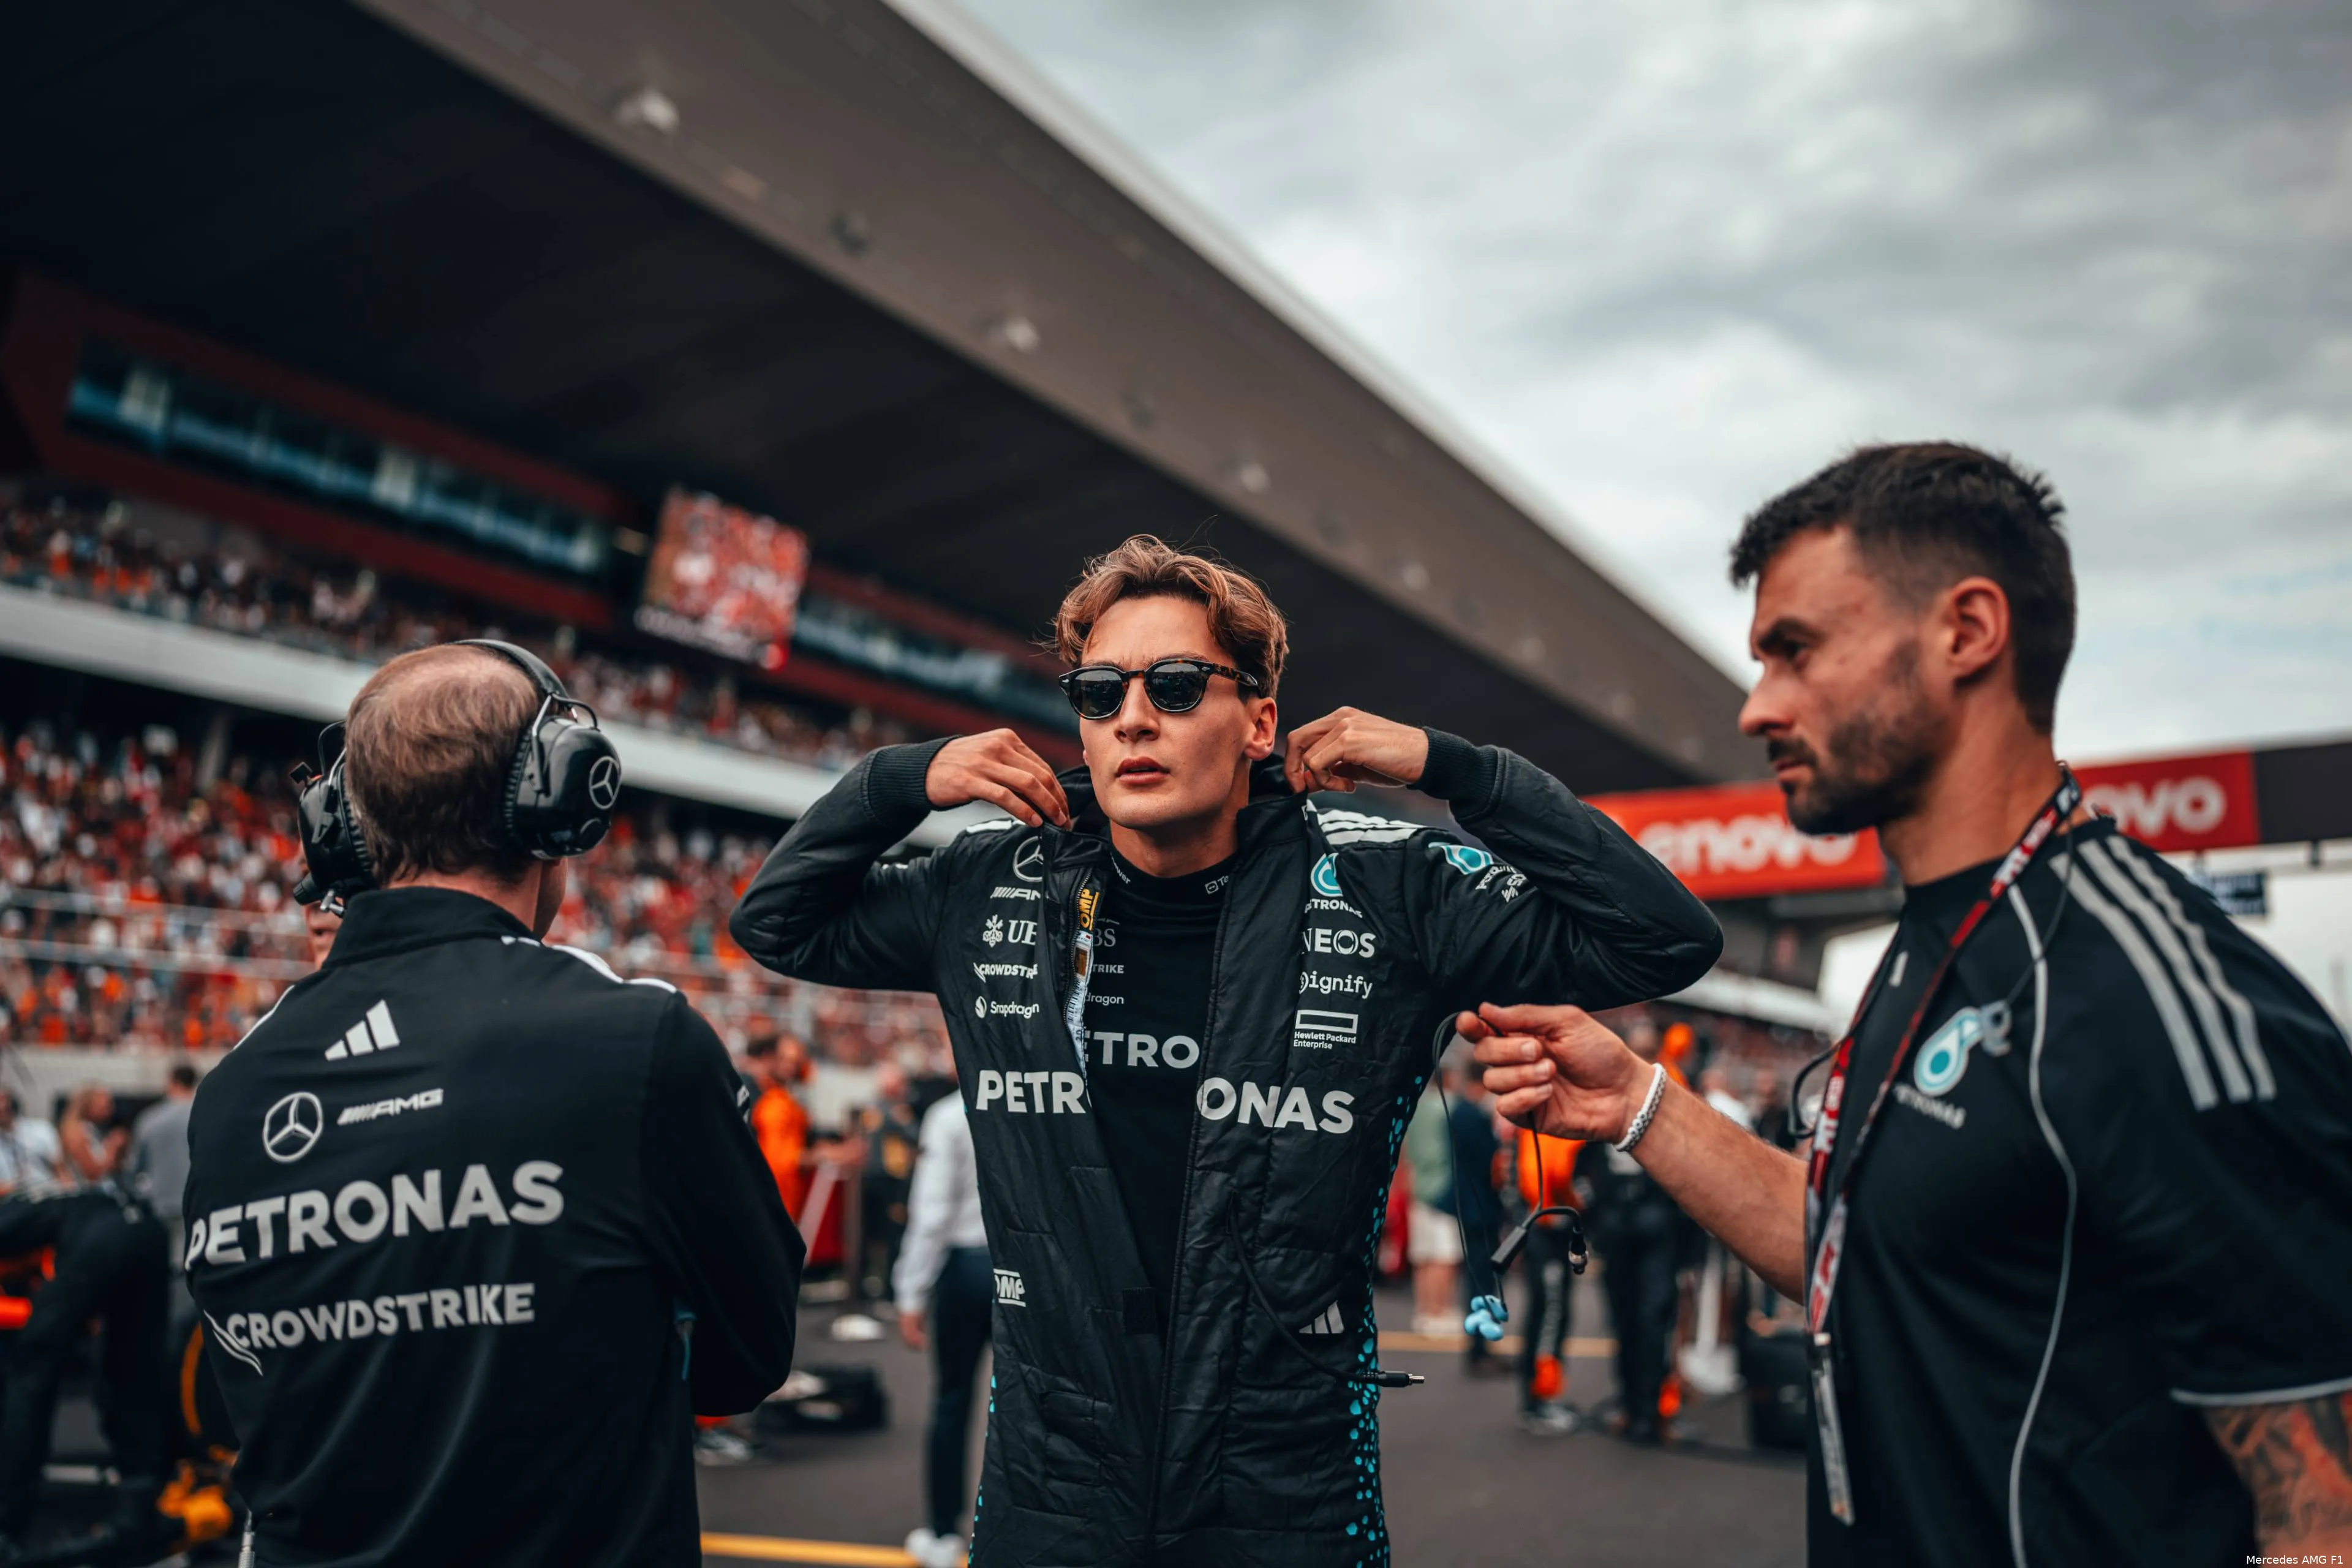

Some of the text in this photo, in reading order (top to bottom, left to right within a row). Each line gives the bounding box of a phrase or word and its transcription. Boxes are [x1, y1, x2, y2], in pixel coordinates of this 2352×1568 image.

[1623, 812, 1860, 877] enovo
[1294, 1031, 1356, 1044] Hewlett Packard
[1294, 1039, 1333, 1049] Enterprise
[370, 1088, 443, 1118] AMG
[1196, 1077, 1355, 1134] ONAS
[185, 1160, 564, 1271] PETRONAS
[226, 1283, 535, 1349] CROWDSTRIKE
